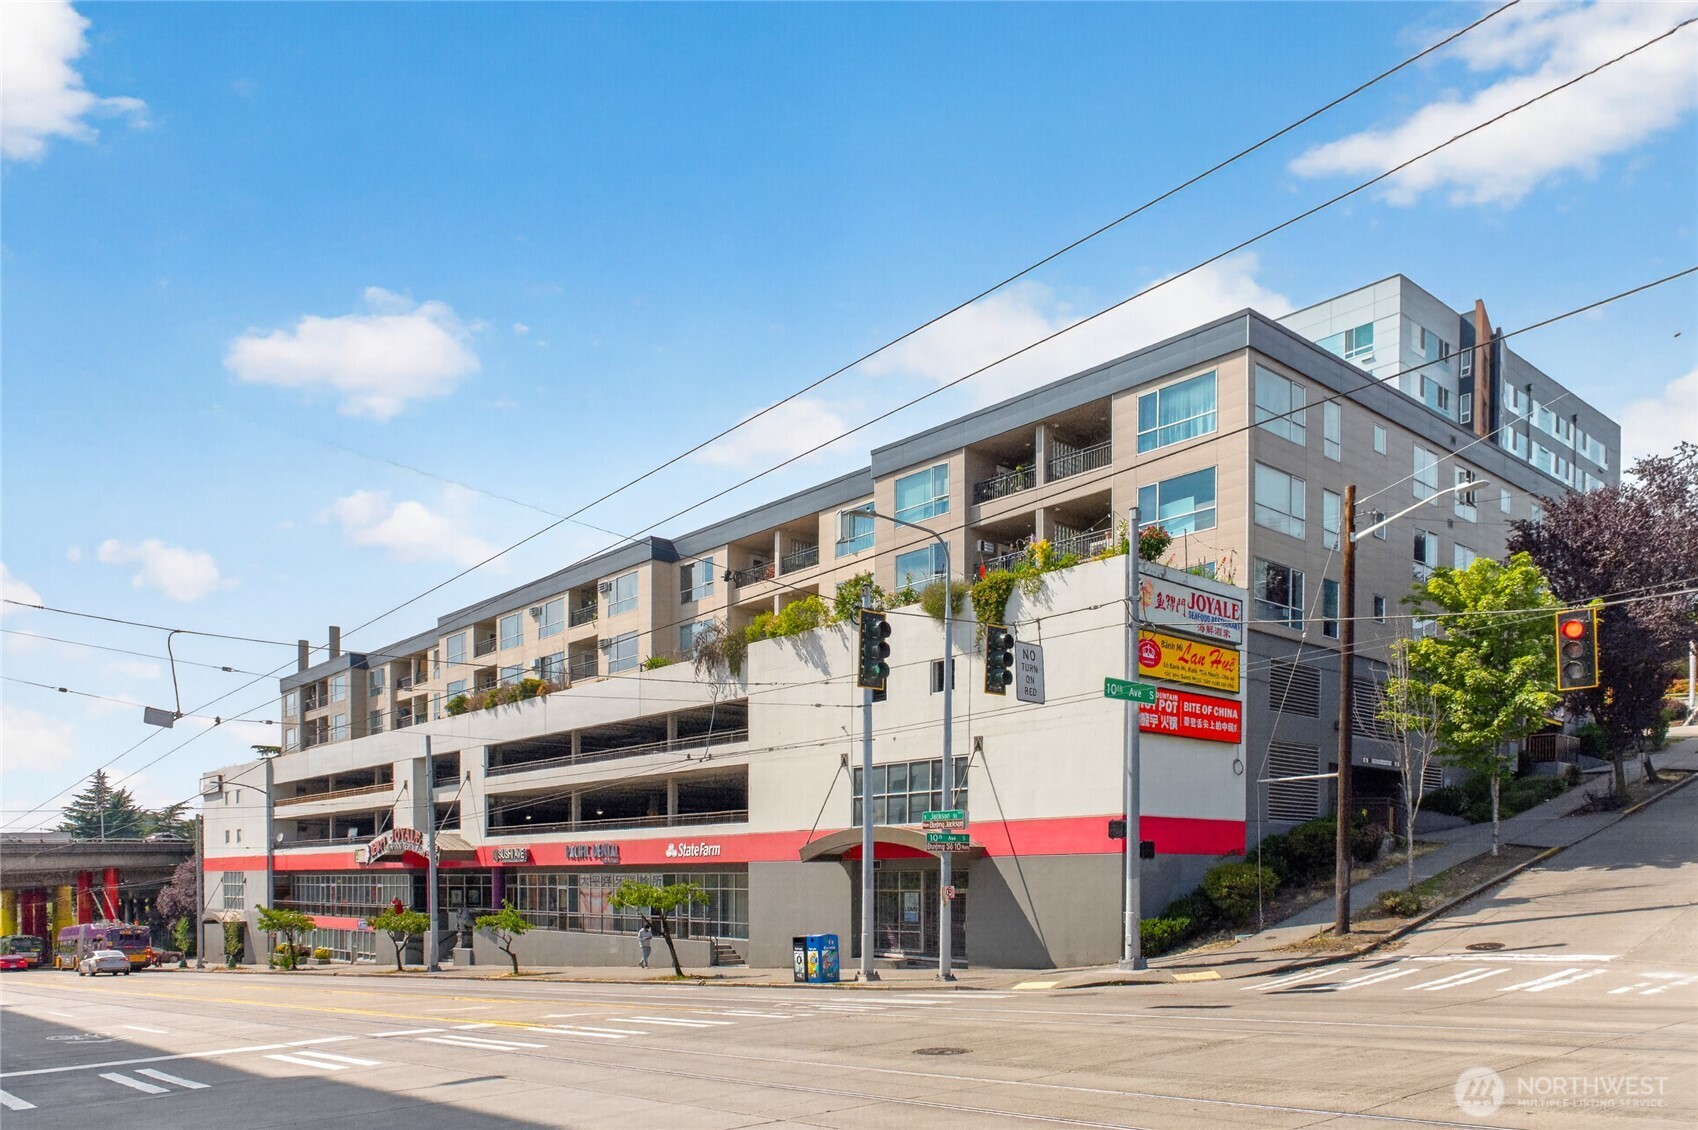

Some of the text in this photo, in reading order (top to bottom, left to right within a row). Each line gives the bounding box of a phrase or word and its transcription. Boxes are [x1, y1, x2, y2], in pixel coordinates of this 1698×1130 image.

[1187, 592, 1240, 621] JOYALE
[1188, 611, 1210, 622] SEAFOOD
[1022, 649, 1036, 662] NO
[1178, 642, 1206, 666] Lan
[1021, 663, 1039, 673] TURN
[1025, 675, 1035, 684] ON
[1024, 687, 1037, 697] RED
[1107, 683, 1155, 700] 10th Ave S
[1155, 692, 1179, 701] OUNTAIN
[1159, 699, 1178, 713] POT
[1184, 702, 1238, 719] BITE OF CHINA
[930, 812, 951, 820] Jackson
[945, 820, 964, 828] Jackson
[565, 844, 619, 859] PACIFIC DENTAL
